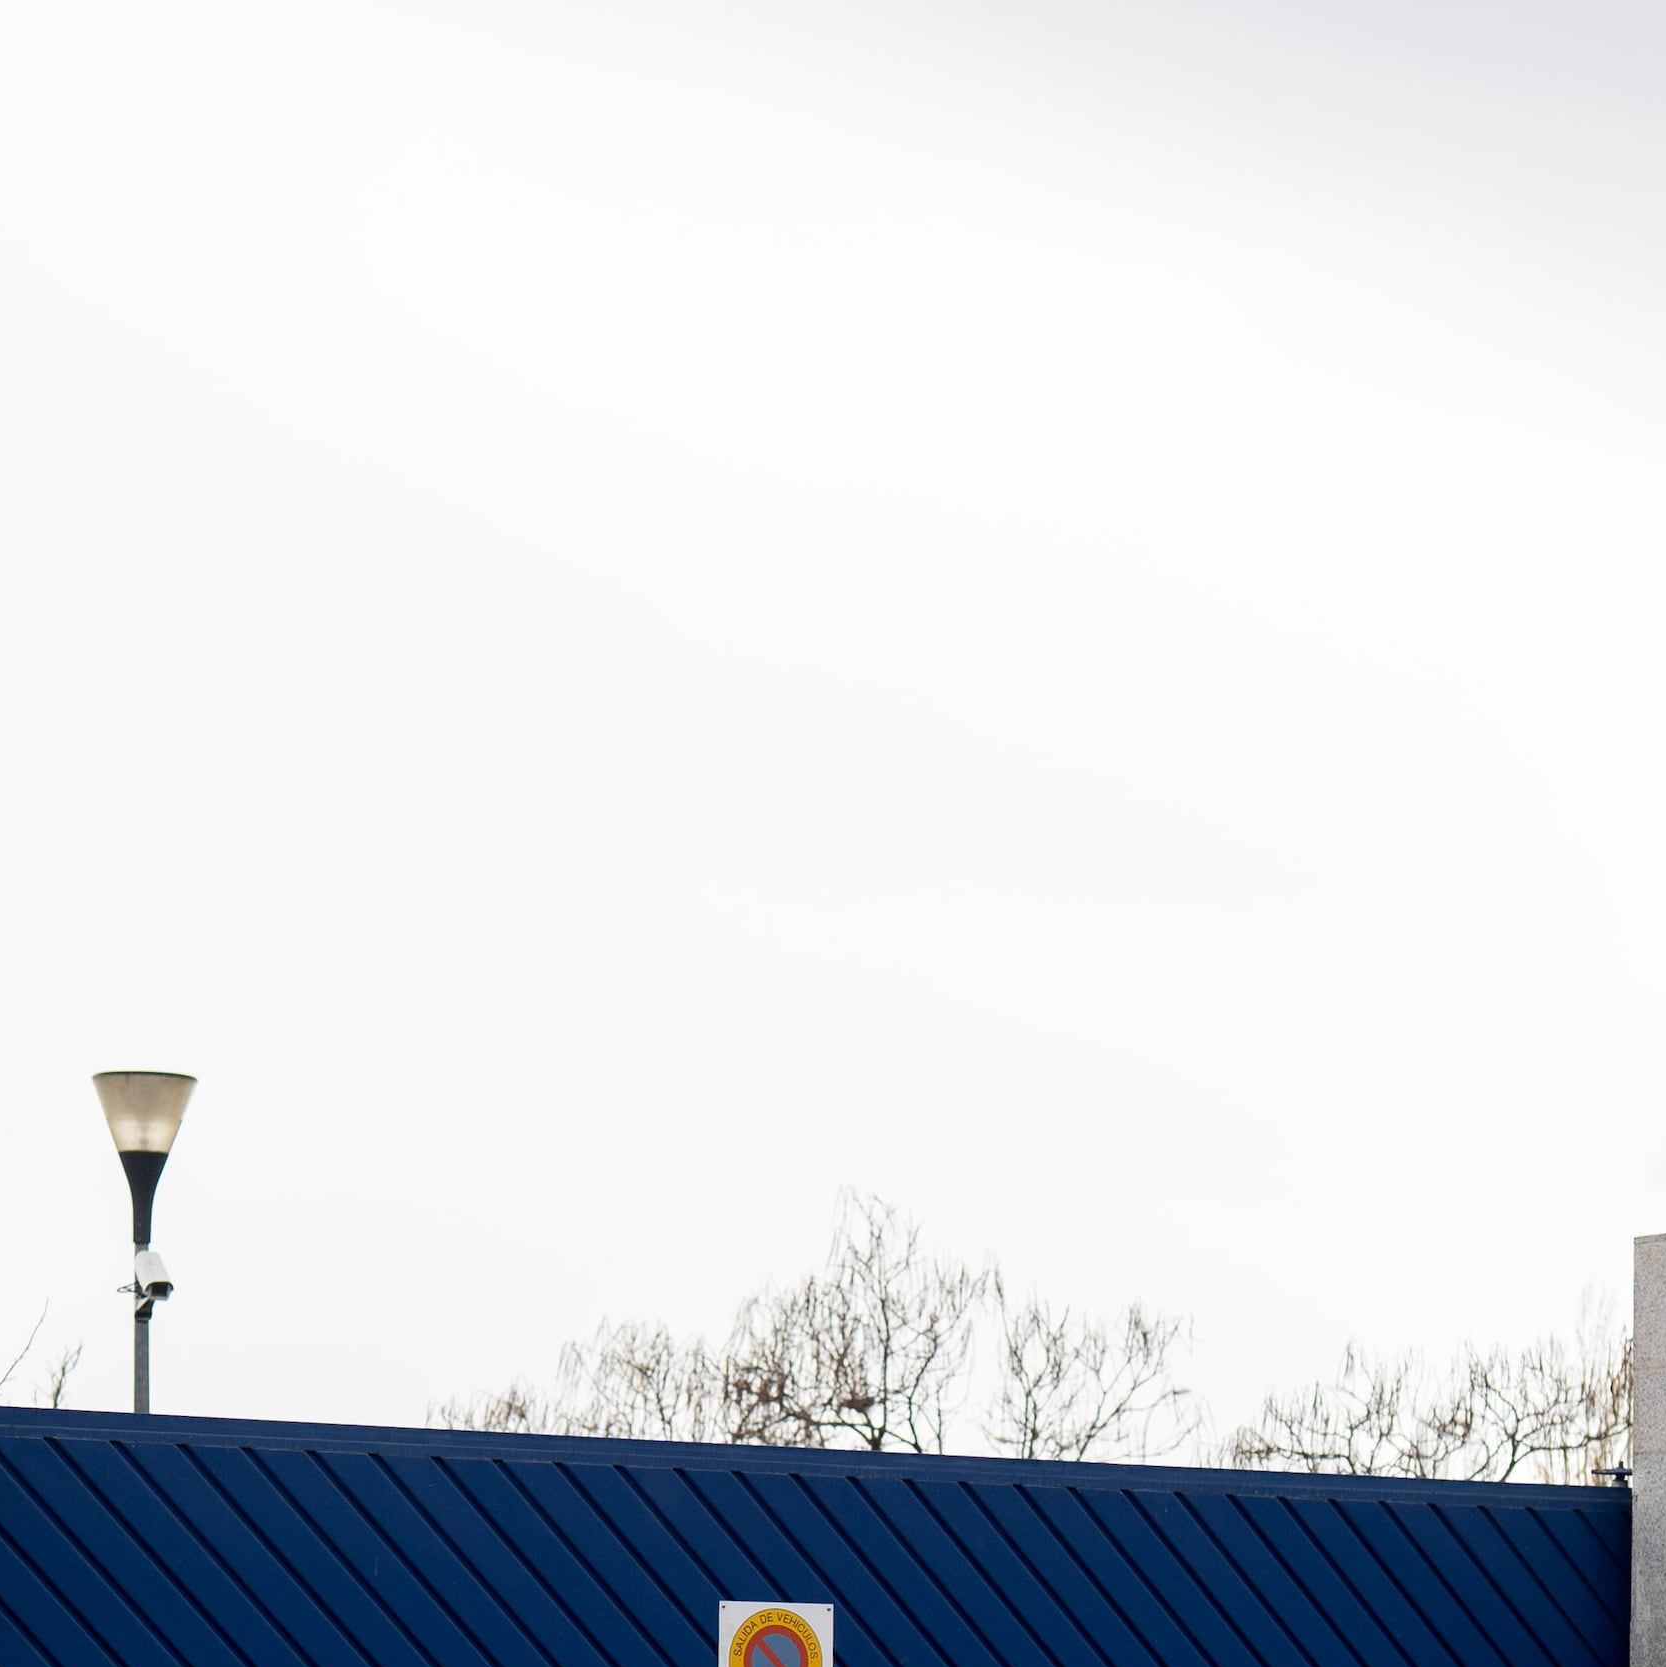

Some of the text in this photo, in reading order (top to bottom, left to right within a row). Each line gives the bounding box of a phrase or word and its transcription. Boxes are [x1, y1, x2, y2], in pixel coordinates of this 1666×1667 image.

[733, 1611, 819, 1659] SALIDA DE VEHICULOS
